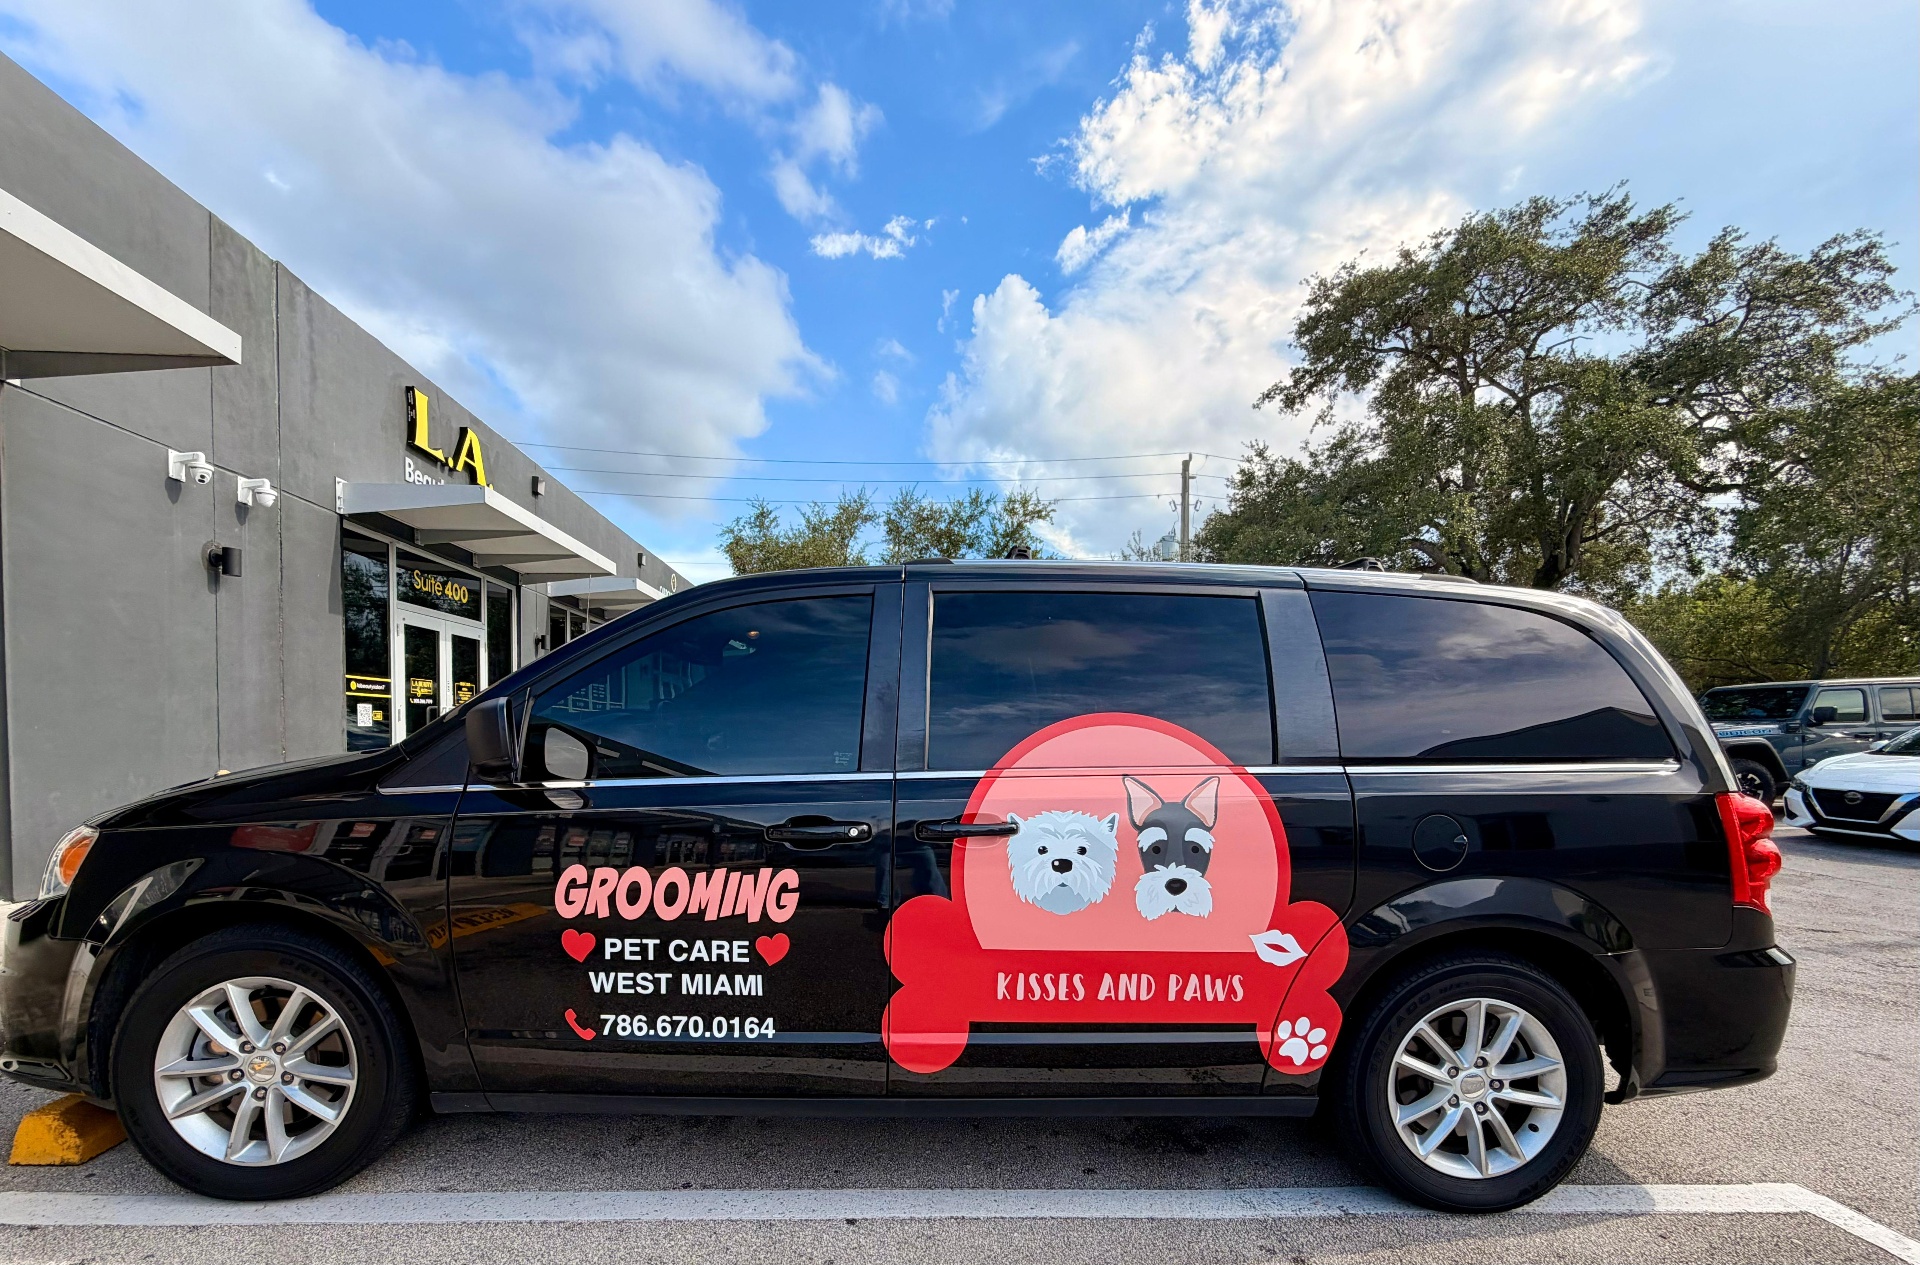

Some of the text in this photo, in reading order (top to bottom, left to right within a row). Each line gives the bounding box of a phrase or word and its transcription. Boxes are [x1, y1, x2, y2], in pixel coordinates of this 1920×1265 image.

[413, 569, 468, 603] Suite 400
[554, 864, 800, 923] GROOMING
[604, 938, 750, 962] PET CARE
[588, 972, 763, 996] WEST MIAMI
[997, 972, 1244, 1002] KISSES AND PAWS
[600, 1014, 776, 1039] 786.670.0164
